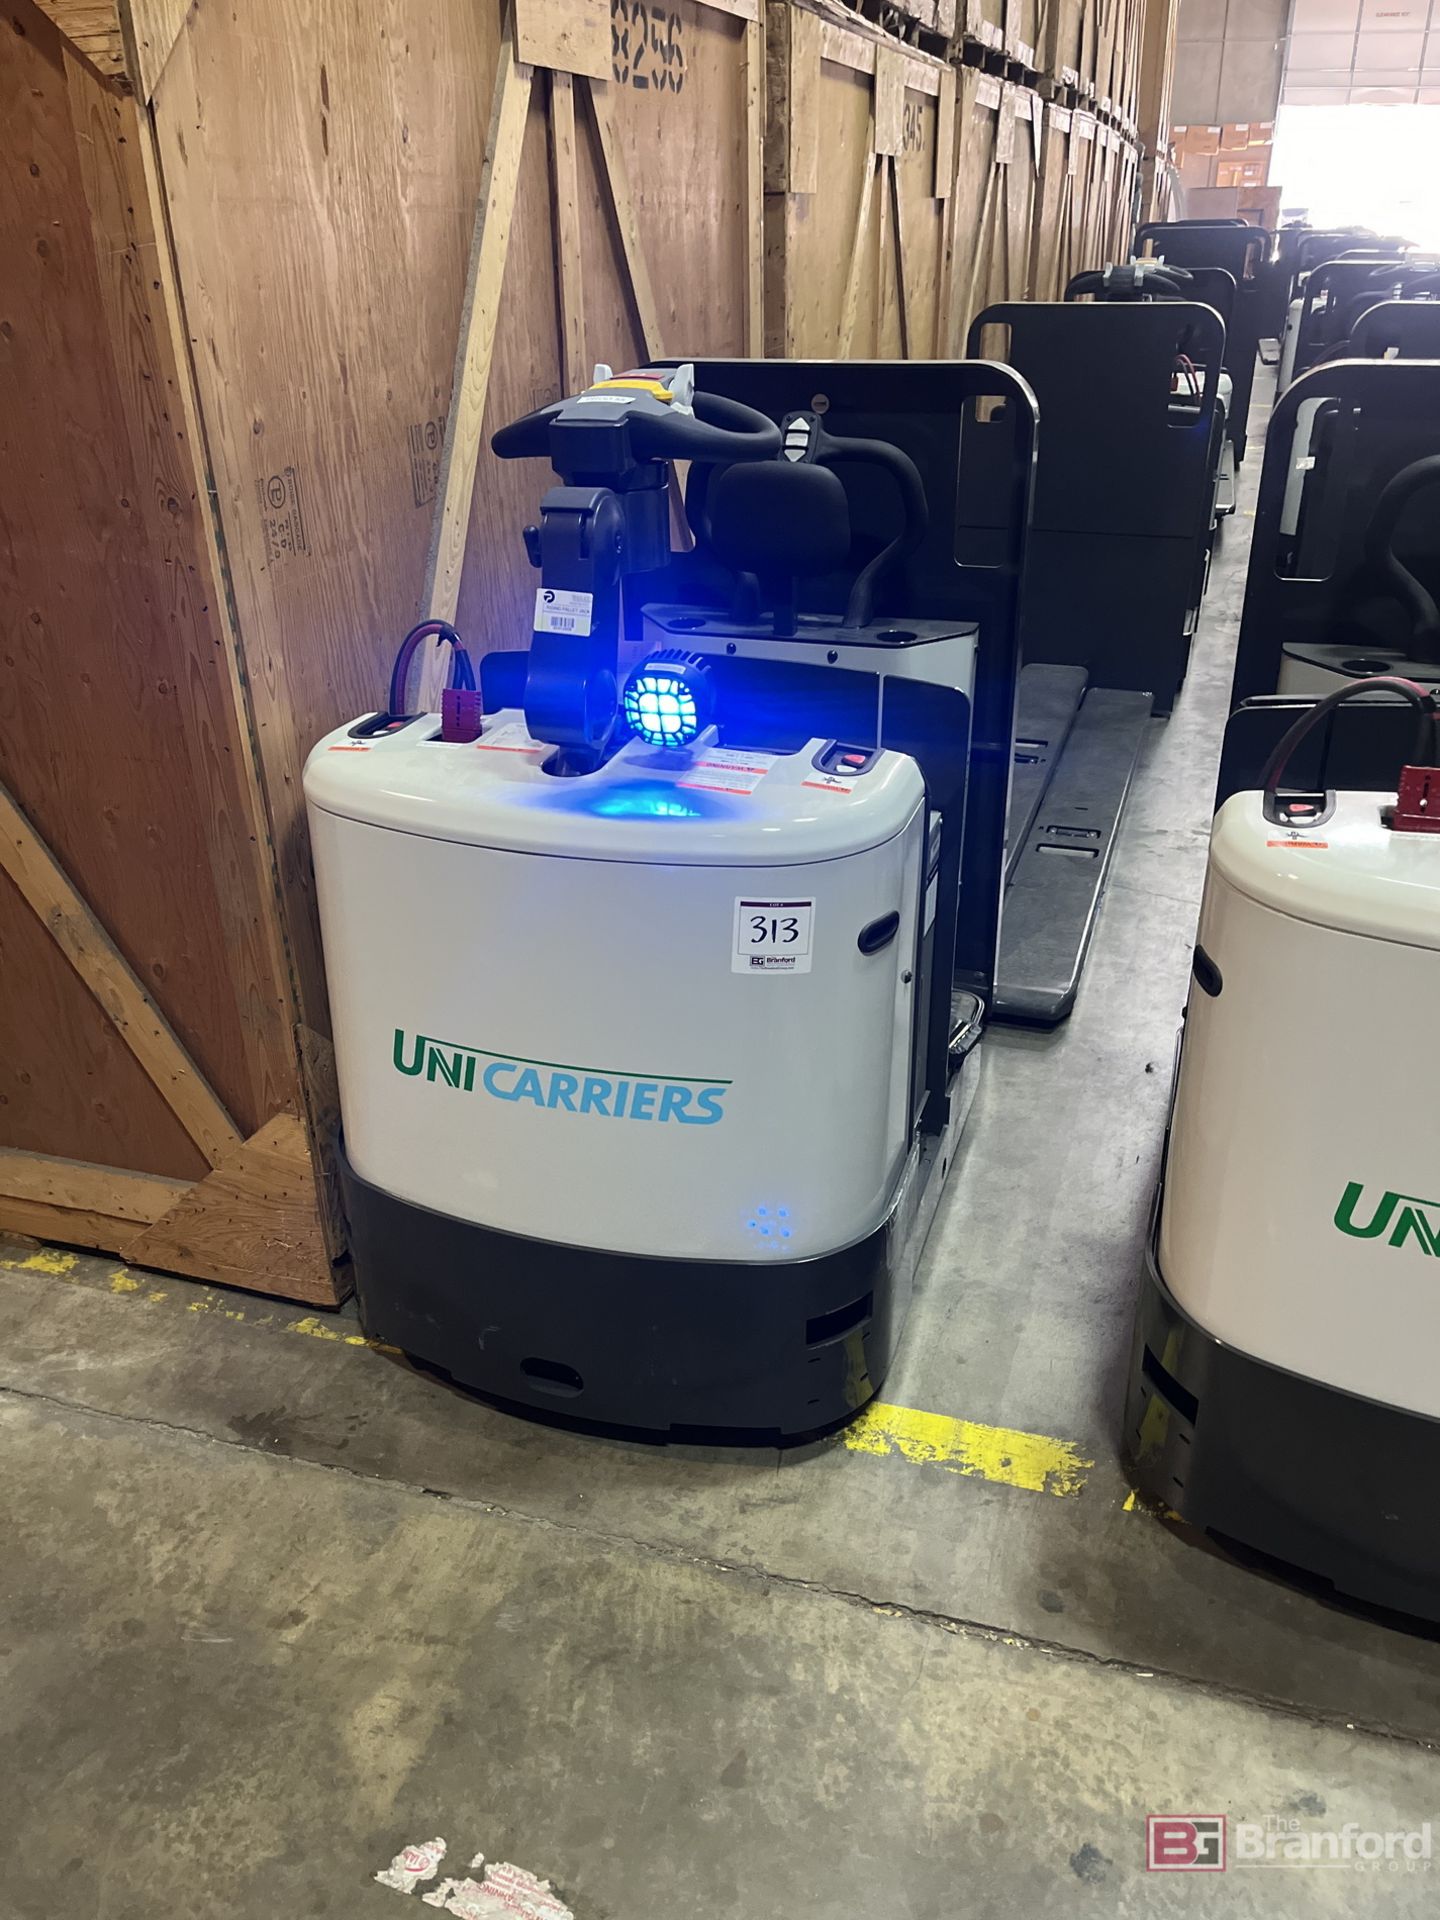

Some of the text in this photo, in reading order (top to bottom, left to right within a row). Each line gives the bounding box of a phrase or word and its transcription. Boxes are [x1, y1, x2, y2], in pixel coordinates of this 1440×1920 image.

[611, 0, 683, 94] 8256
[750, 915, 799, 944] 313
[766, 956, 796, 964] Branford
